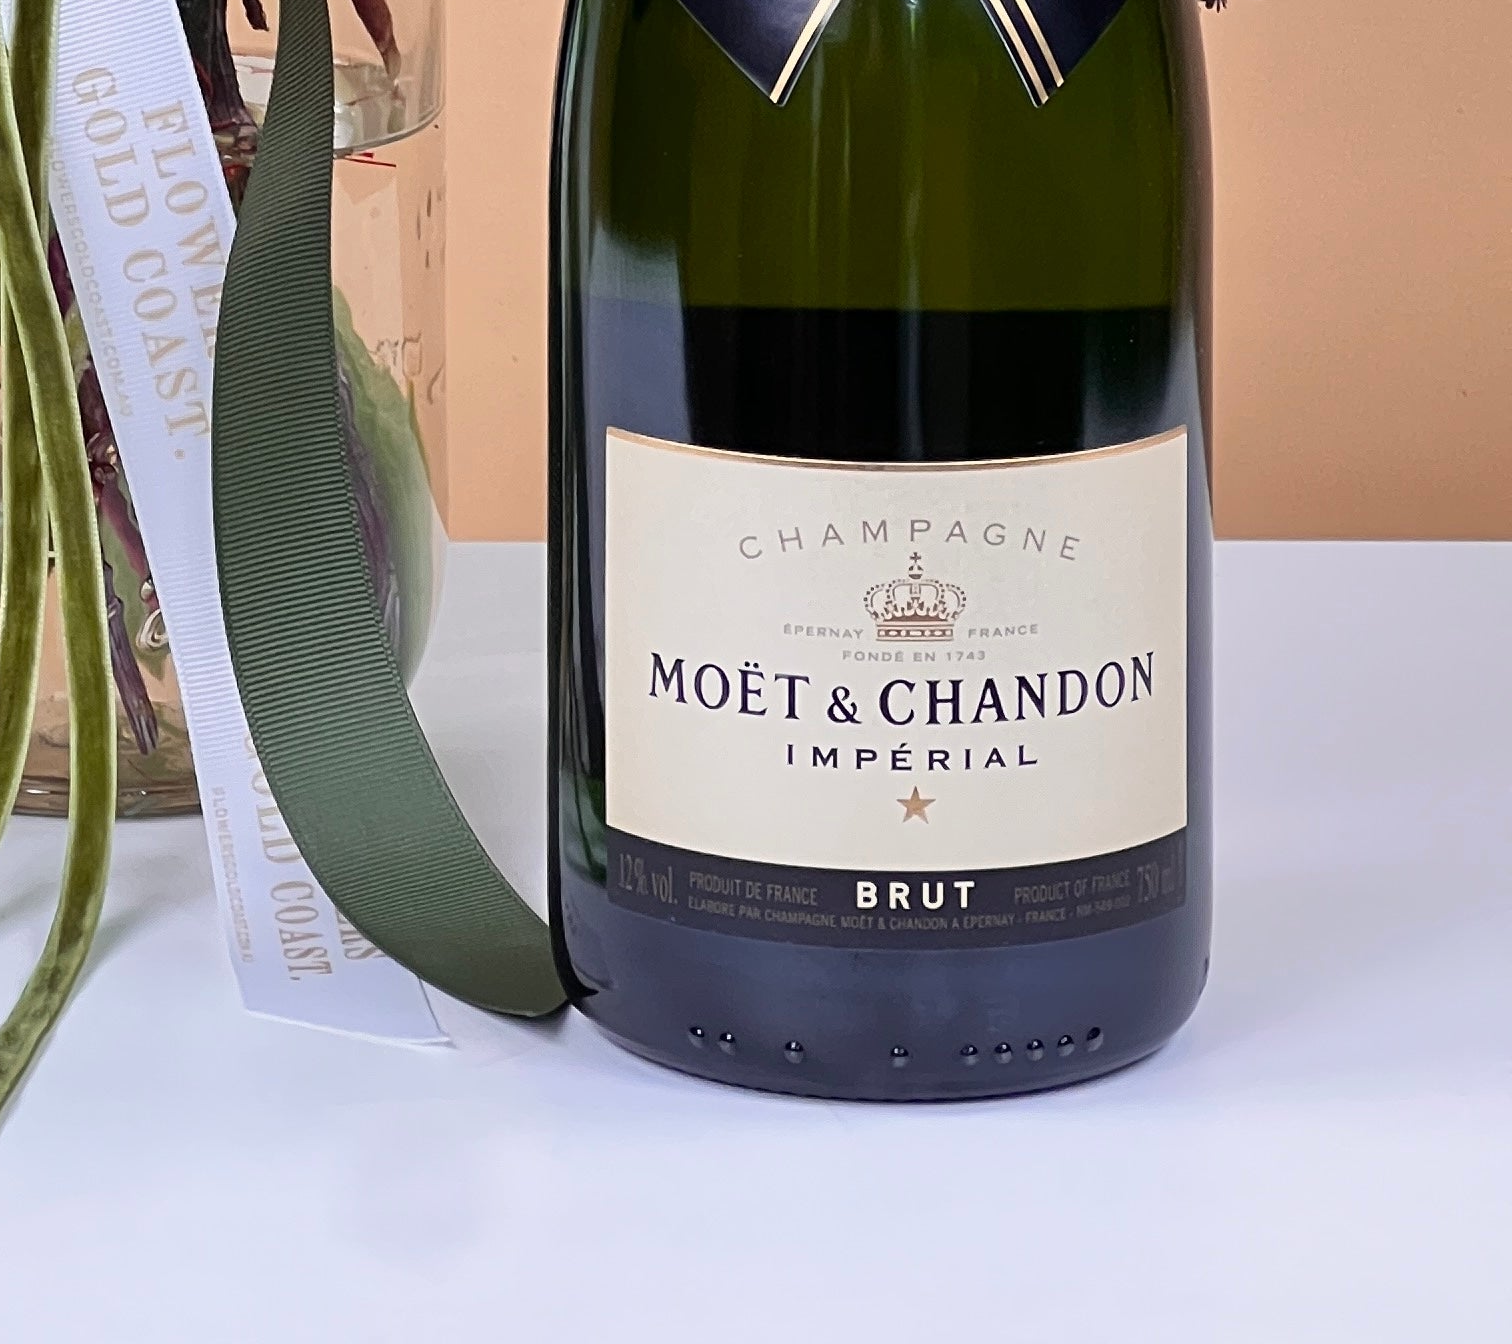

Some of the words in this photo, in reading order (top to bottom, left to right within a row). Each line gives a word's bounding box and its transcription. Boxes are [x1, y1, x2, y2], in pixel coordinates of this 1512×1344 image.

[142, 100, 228, 359] FLOWE
[72, 67, 150, 228] GOLD
[122, 248, 211, 459] COAST.
[738, 518, 1081, 562] CHAMPAGNE
[782, 623, 865, 640] ÉPERNAY
[967, 623, 1040, 639] FRANCE
[912, 651, 937, 663] EN
[945, 649, 987, 662] 1743
[648, 651, 811, 721] MOËT
[826, 685, 863, 724] &
[878, 650, 1156, 727] CHANDON
[785, 742, 1039, 772] IMPÉRIAL
[651, 865, 679, 905] vol.
[688, 871, 743, 897] PRODUIT
[745, 880, 763, 901] DE
[766, 883, 819, 906] FRANCE
[855, 880, 976, 910] BRUT
[1013, 879, 1071, 905] PRODUCT
[1073, 877, 1088, 898] OF
[764, 909, 837, 928] CHAMPAGNE
[889, 916, 949, 931] CHANDON
